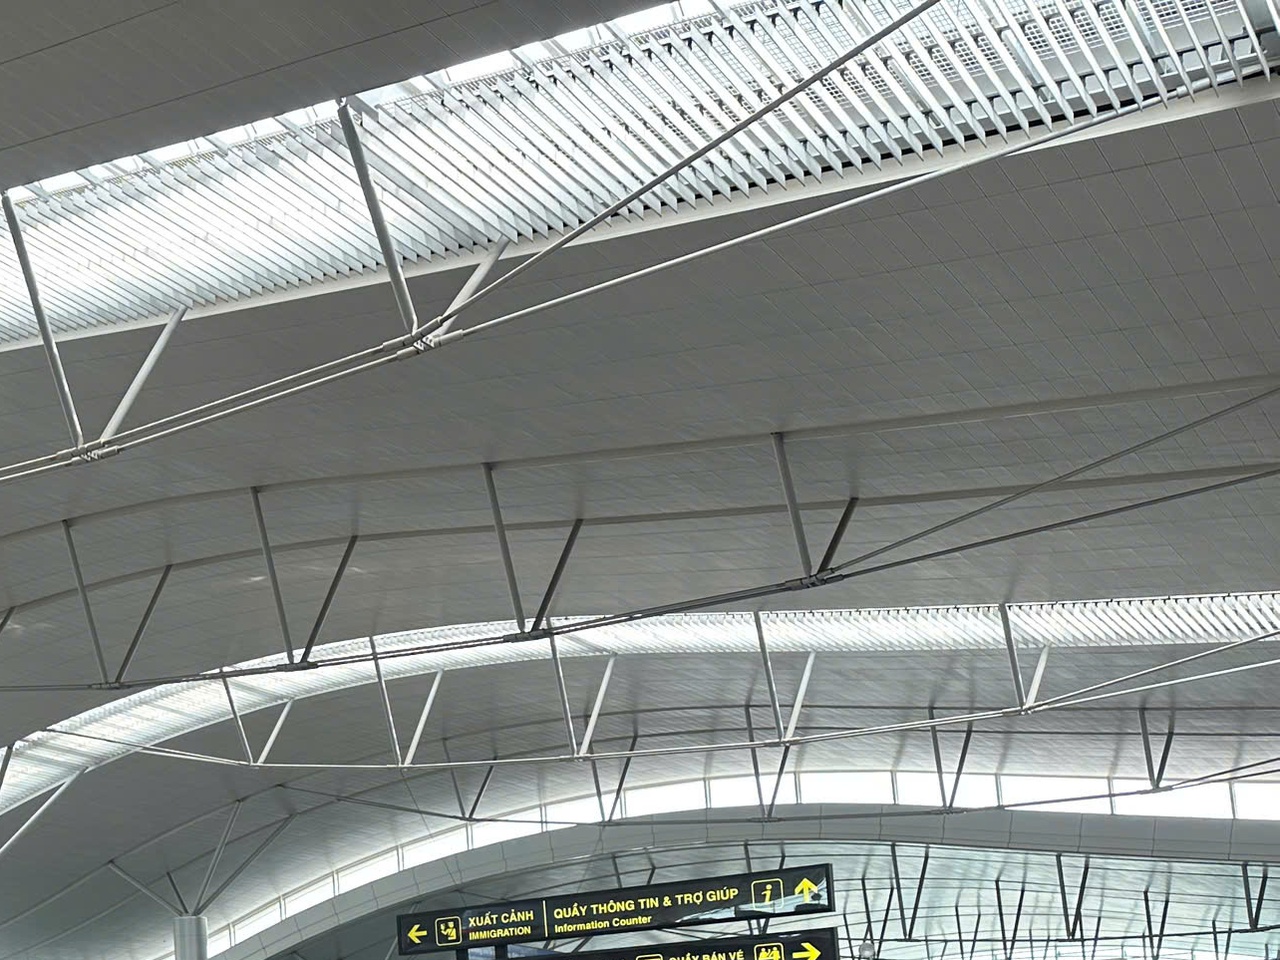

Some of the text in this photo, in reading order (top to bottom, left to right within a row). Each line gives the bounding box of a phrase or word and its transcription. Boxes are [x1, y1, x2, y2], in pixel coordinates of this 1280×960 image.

[553, 886, 739, 919] QUẦY THÔNG TIN & TRỢ GIÚP
[468, 909, 534, 927] XUẤT CẢNH
[555, 916, 652, 933] Information Counter
[469, 926, 531, 940] IMMIGRATION
[728, 949, 745, 960] VÉ
